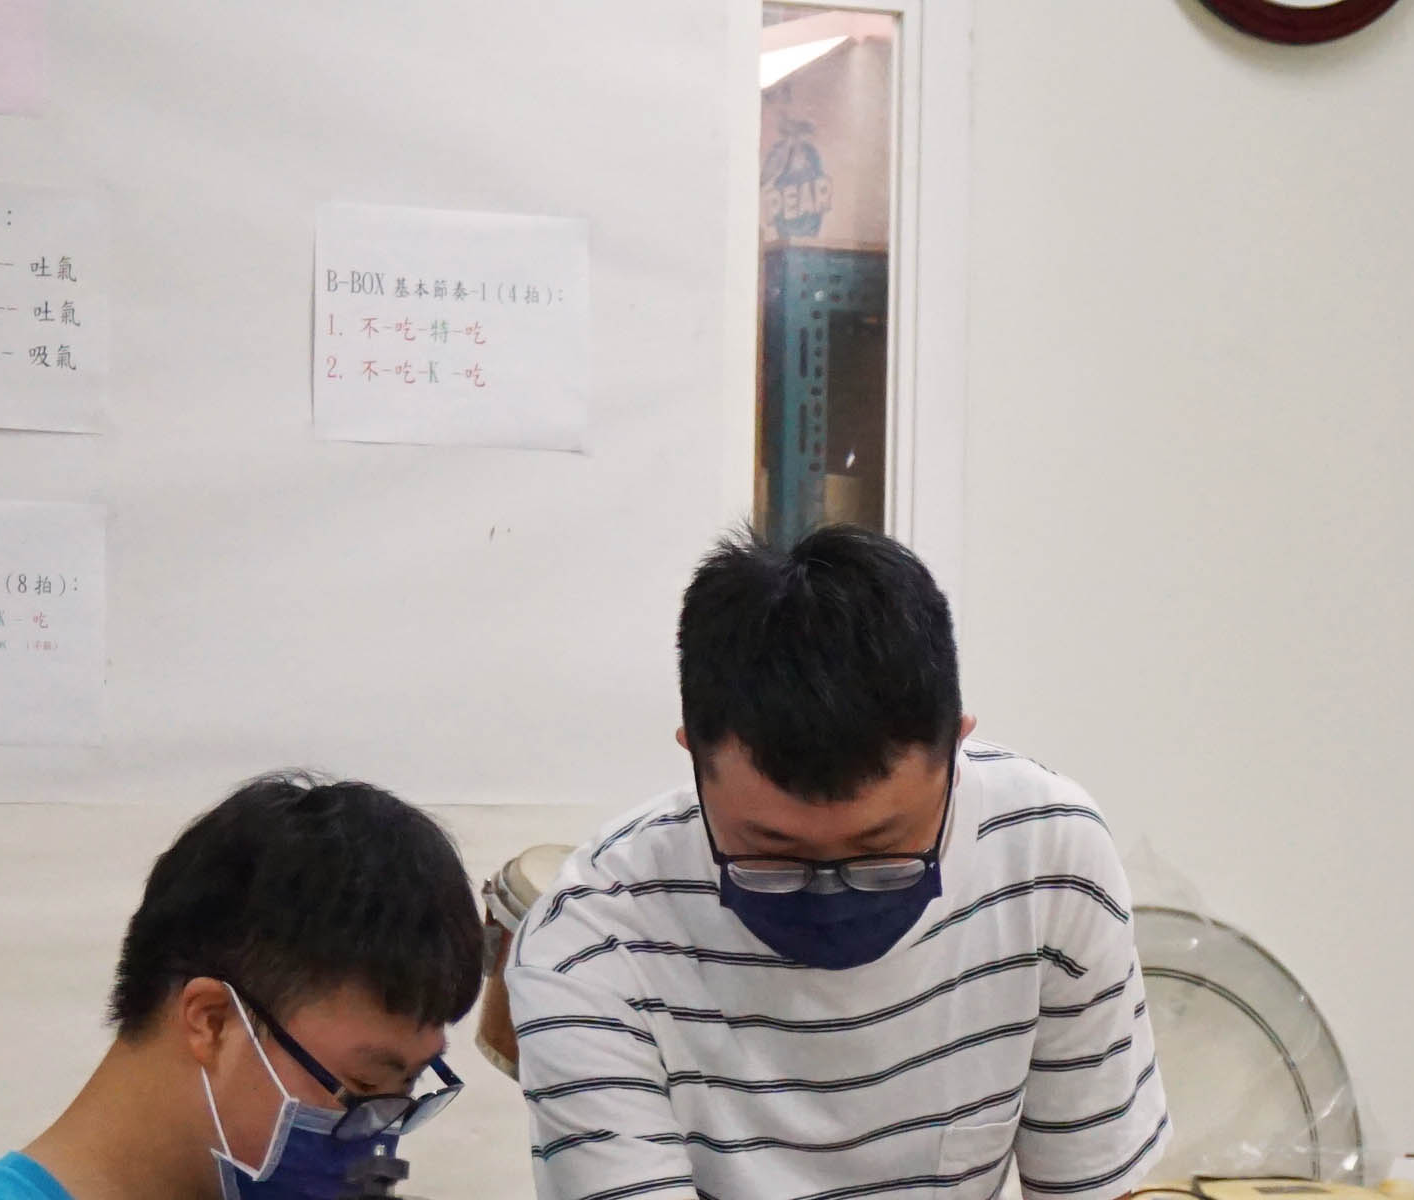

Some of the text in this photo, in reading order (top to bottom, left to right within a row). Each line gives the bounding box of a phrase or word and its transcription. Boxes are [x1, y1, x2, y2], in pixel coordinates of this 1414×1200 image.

[30, 256, 77, 282] 吐氣
[326, 269, 386, 296] B-BOX
[33, 301, 81, 327] 吐氣
[29, 344, 77, 370] 吸氣
